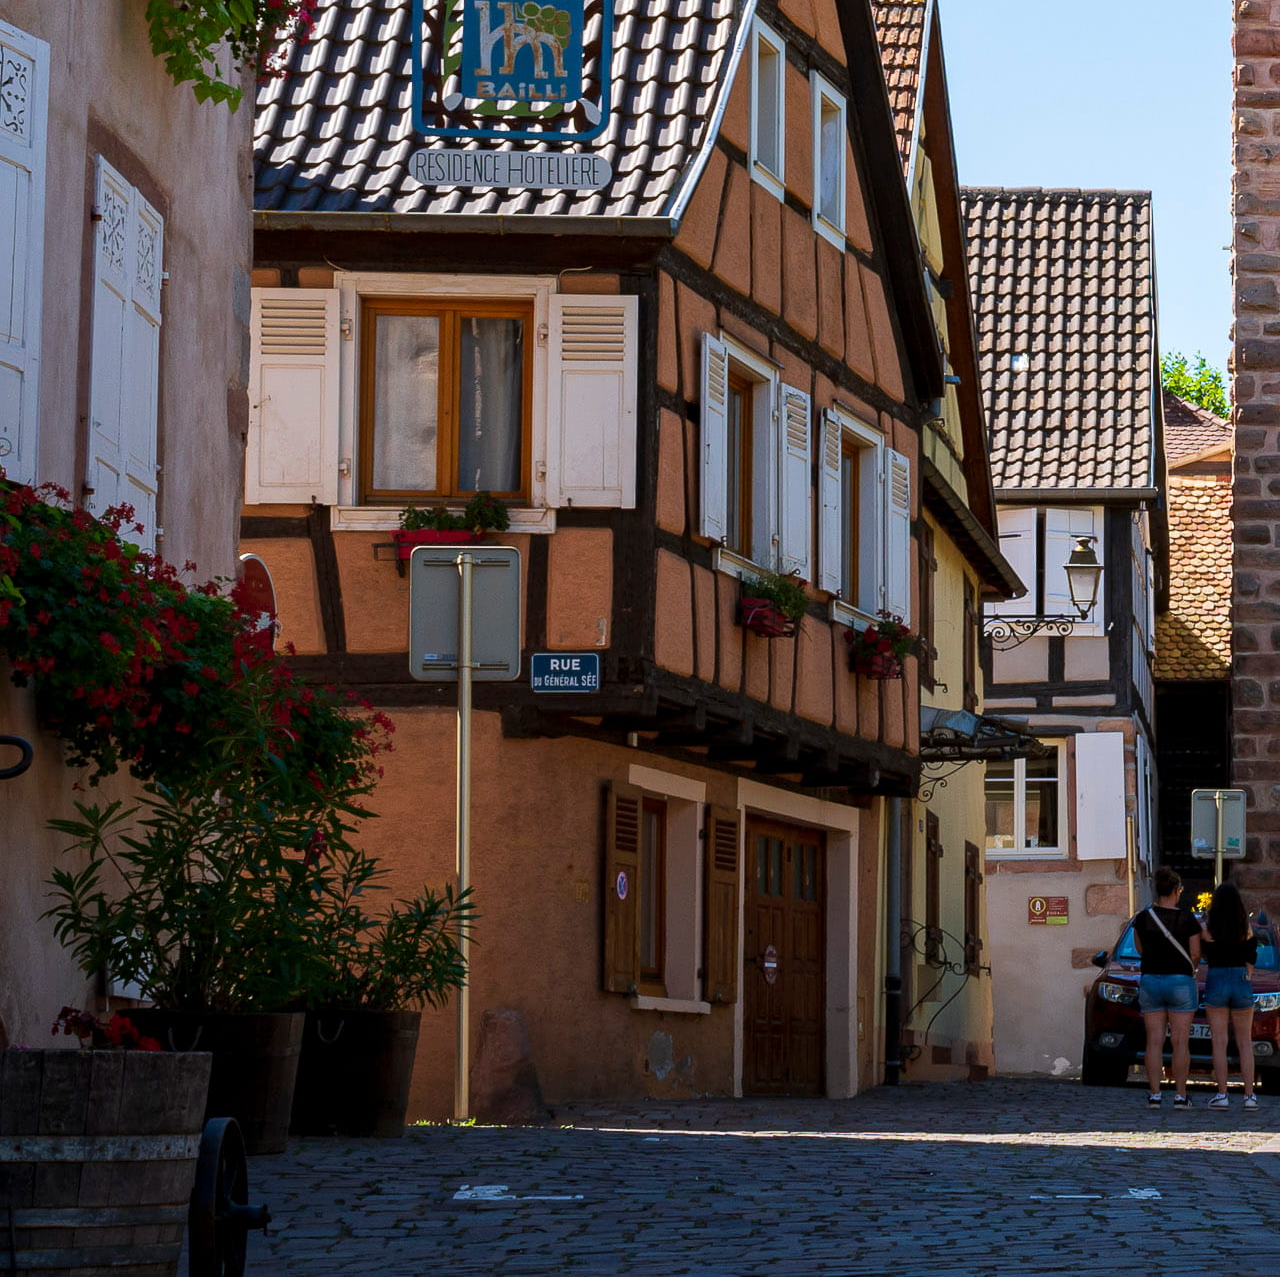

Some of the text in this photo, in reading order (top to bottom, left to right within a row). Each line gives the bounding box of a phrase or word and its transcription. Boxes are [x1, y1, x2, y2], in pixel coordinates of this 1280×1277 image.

[415, 152, 600, 186] RESIDENCE HOTELIERE
[550, 658, 581, 671] RUE
[544, 673, 579, 687] GÉNÉRAL
[581, 672, 597, 687] SÉE
